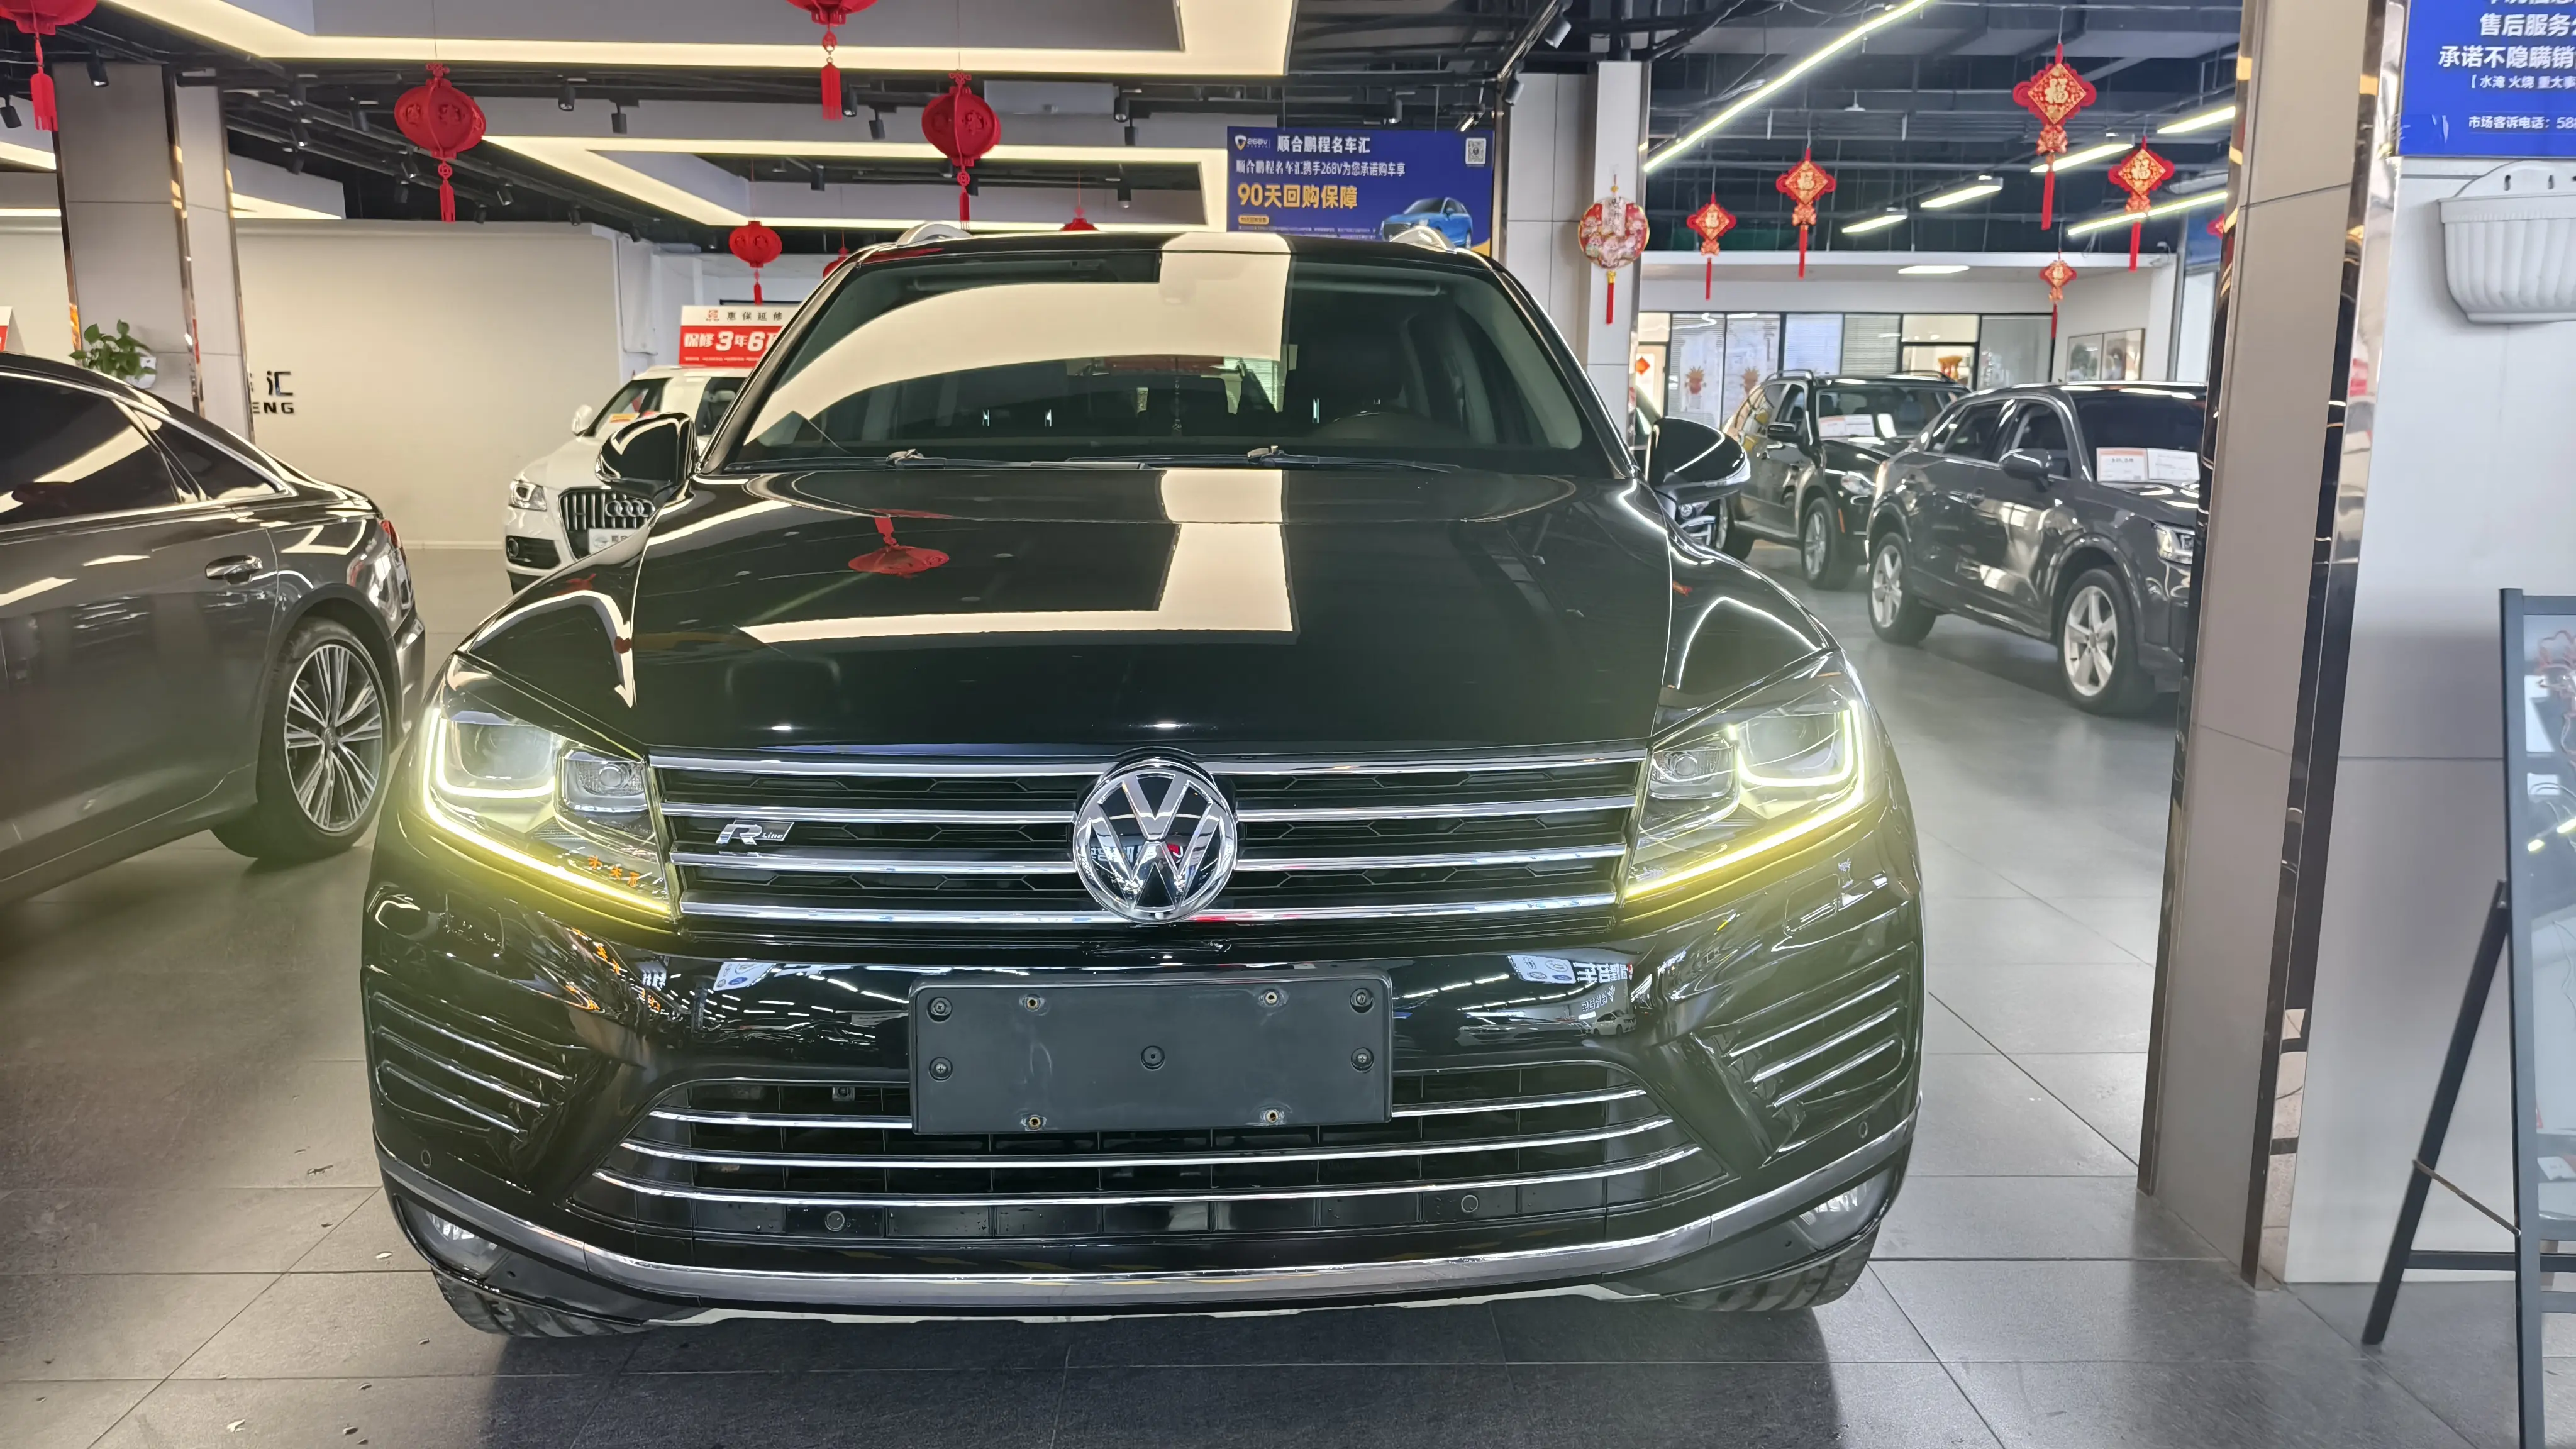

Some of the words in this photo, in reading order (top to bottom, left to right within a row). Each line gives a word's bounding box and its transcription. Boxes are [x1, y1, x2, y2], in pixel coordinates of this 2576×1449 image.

[2480, 13, 2576, 36] 售后服务
[2438, 45, 2576, 69] 承诺不隐瞒销
[2556, 116, 2576, 129] 58
[1277, 135, 1371, 154] 顺合鹏程名车汇
[1237, 182, 1358, 209] 90天回购保障
